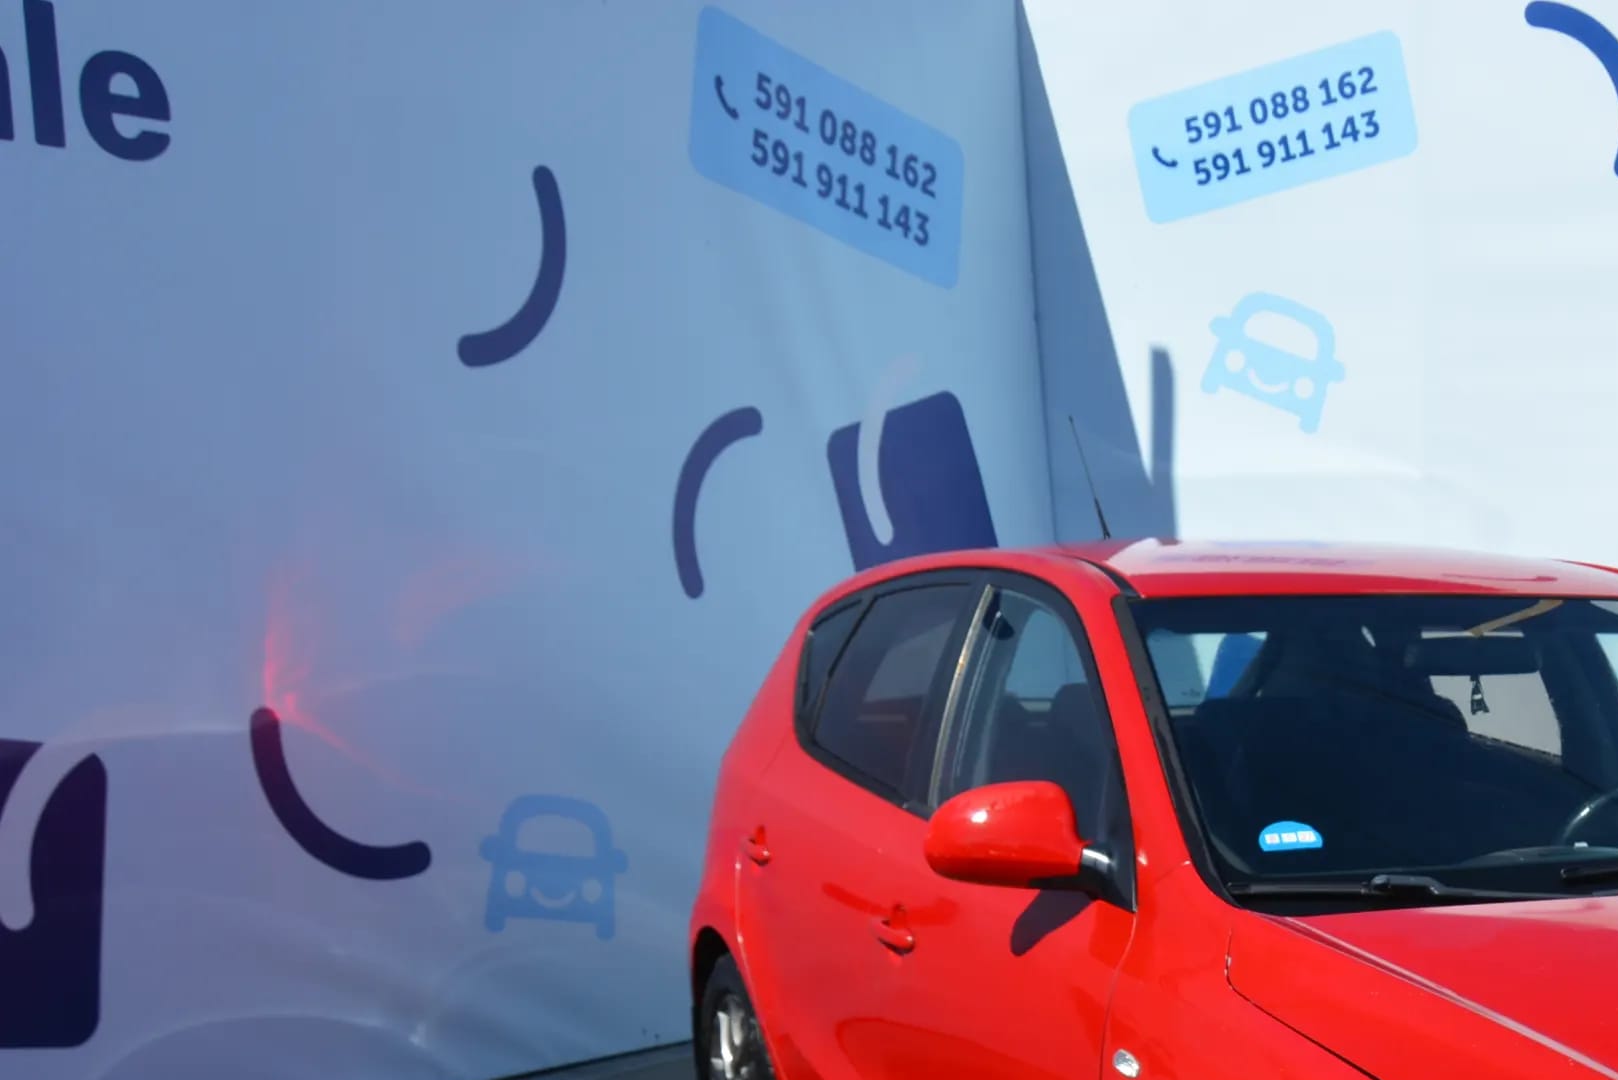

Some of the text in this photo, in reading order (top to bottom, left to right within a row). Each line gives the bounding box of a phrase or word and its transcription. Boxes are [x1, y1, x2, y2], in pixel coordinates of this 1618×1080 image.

[0, 0, 171, 162] le
[754, 72, 937, 199] 591 088 162
[1185, 66, 1378, 144] 591 088 162
[751, 128, 930, 246] 591 911 143
[1193, 110, 1380, 186] 591 911 143
